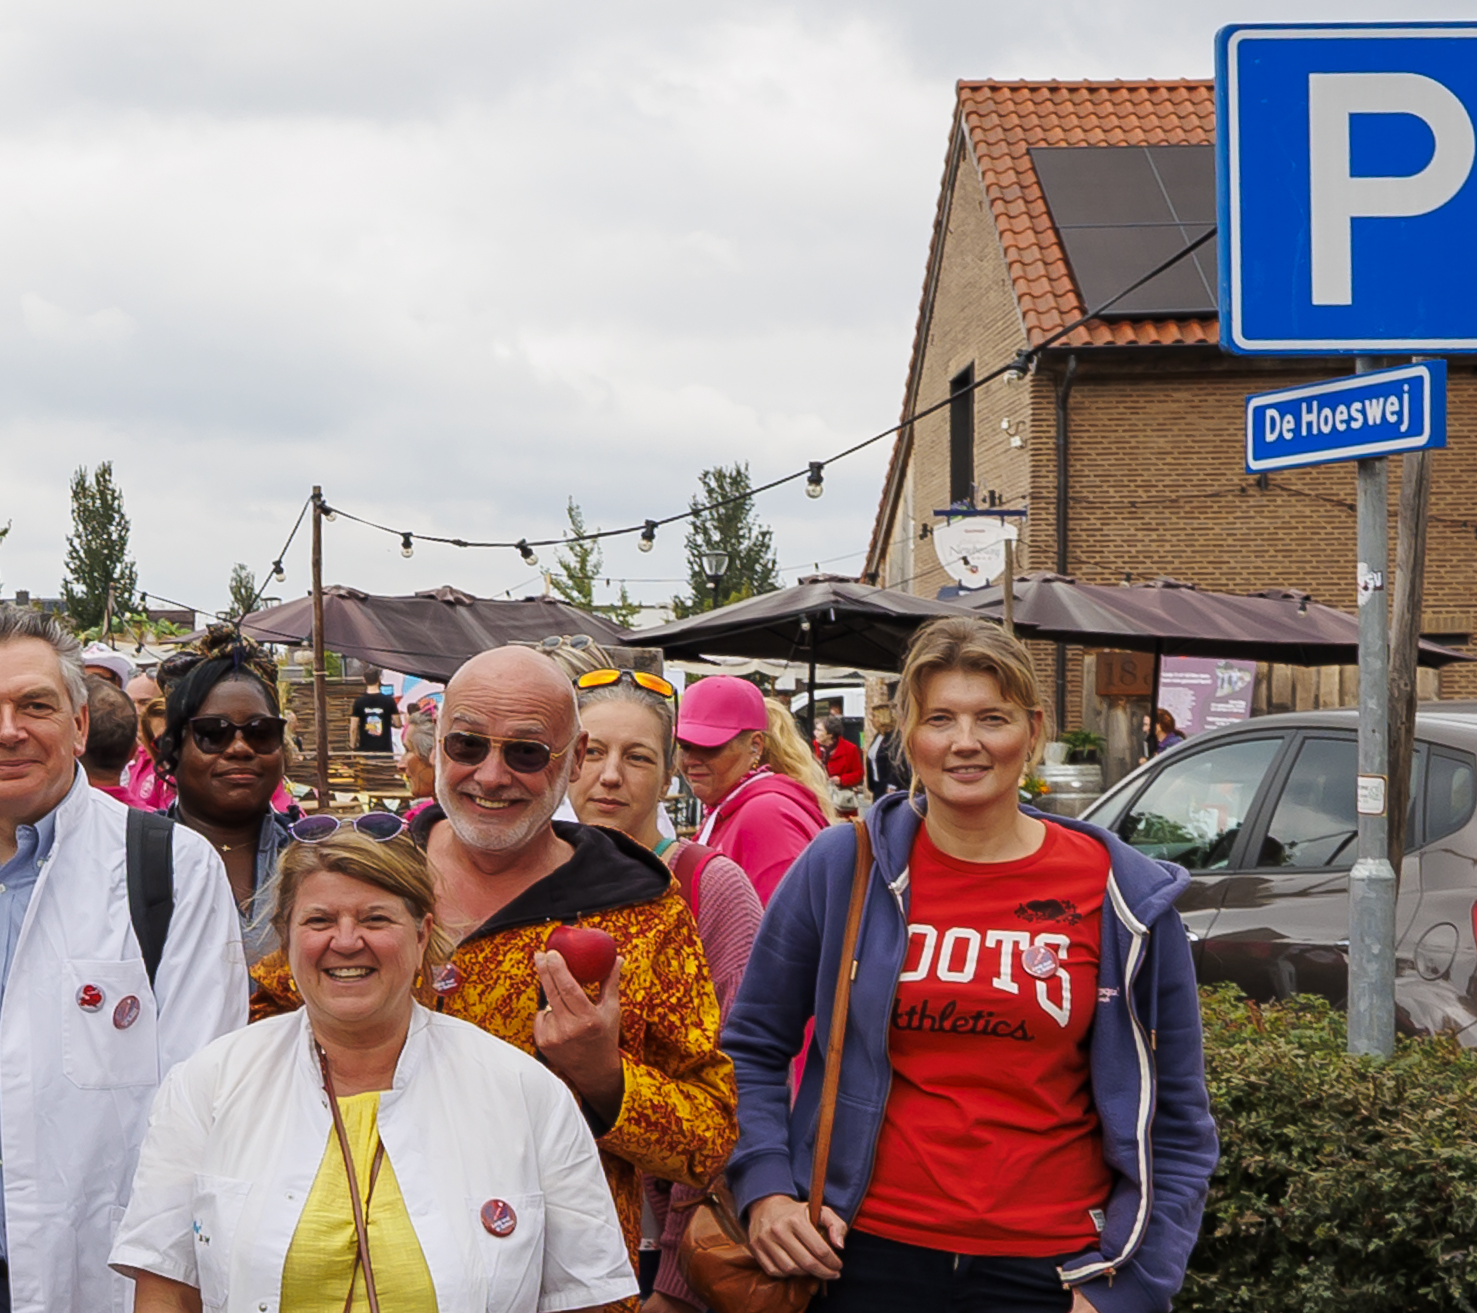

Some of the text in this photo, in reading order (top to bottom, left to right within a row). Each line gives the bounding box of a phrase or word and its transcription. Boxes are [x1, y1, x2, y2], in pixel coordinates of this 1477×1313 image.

[1308, 72, 1476, 306] P
[1265, 384, 1410, 443] De Hoeswej
[1104, 660, 1137, 687] 18
